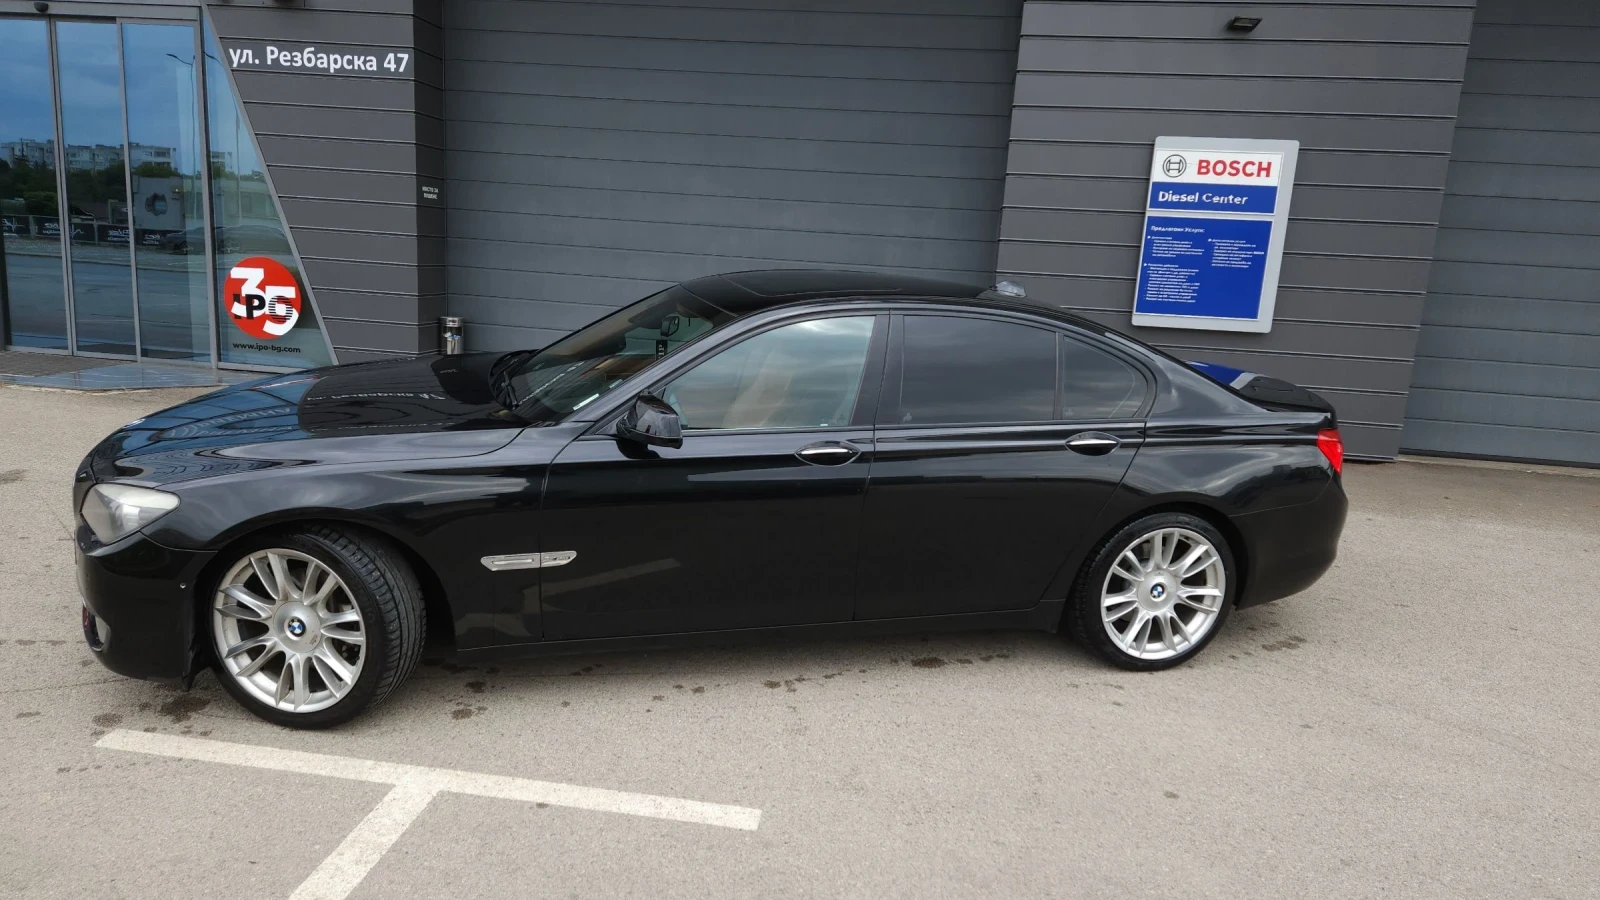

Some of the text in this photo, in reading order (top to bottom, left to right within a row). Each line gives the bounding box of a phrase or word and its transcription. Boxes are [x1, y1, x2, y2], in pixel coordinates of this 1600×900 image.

[228, 46, 409, 73] ул. Резбарска 47
[1197, 159, 1272, 178] BOSCH
[1158, 190, 1248, 205] Diesel Center
[232, 342, 301, 354] www.ipo-bg.com
